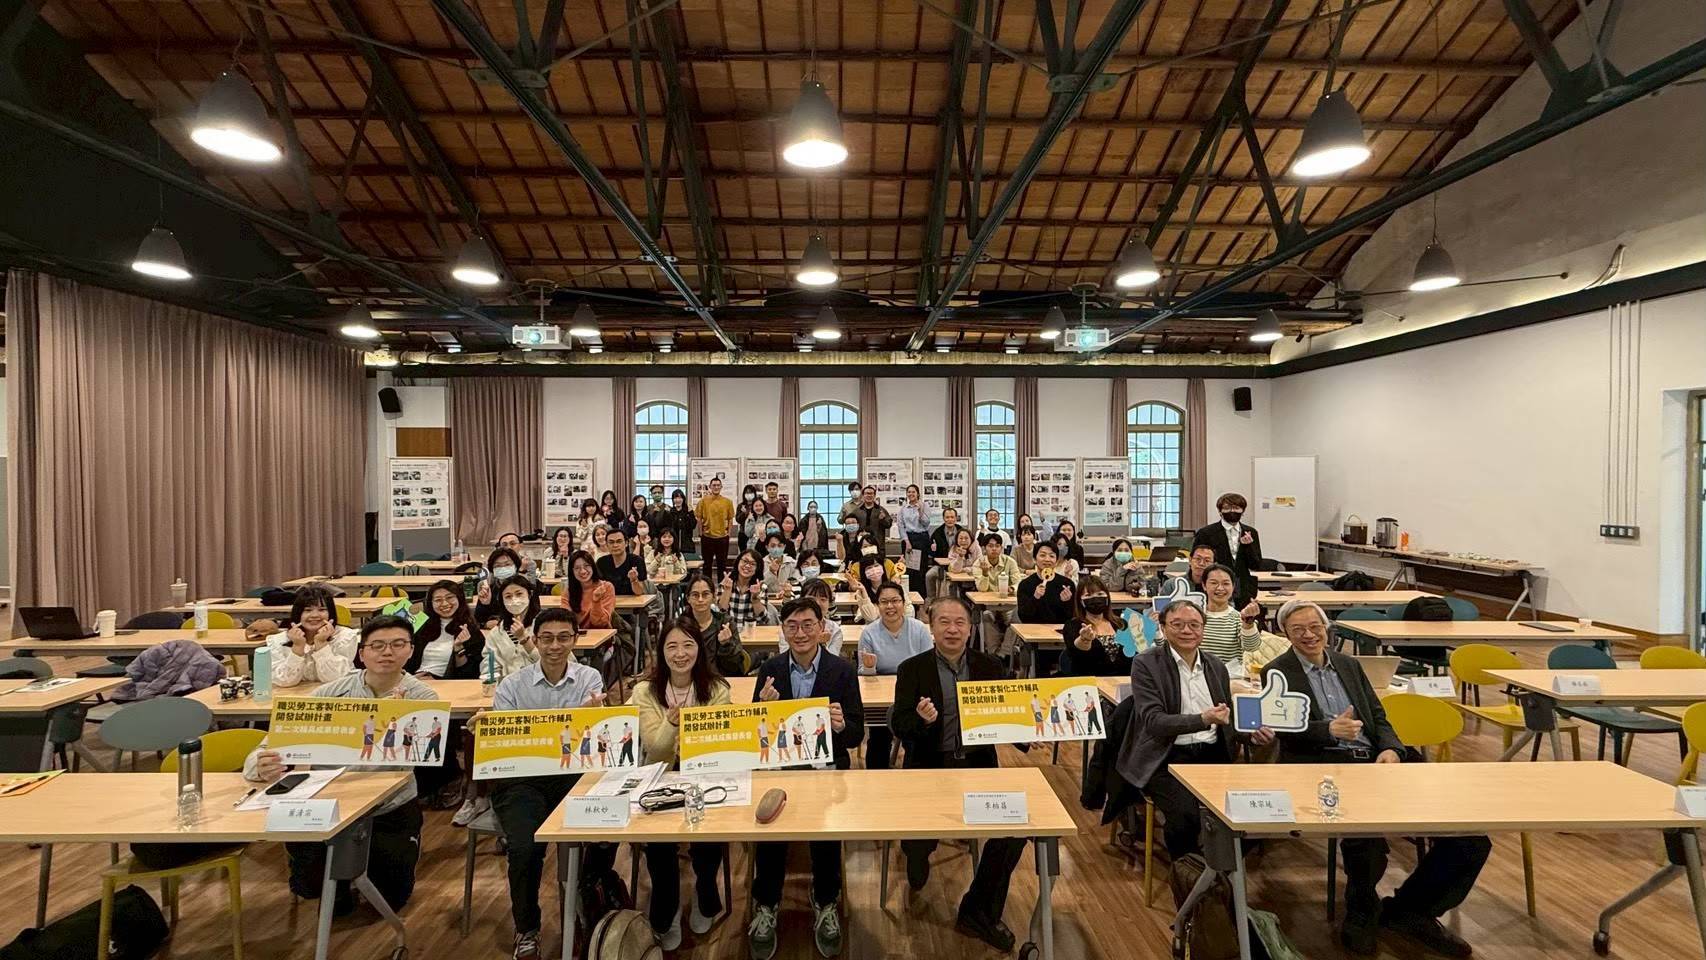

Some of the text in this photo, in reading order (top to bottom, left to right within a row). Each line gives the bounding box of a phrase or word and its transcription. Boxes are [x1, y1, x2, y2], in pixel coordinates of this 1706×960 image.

[961, 684, 1039, 695] 職災勞工客製化工作輔具
[277, 701, 379, 713] 職災勞工客製化工作輔具
[275, 712, 333, 722] 開發試辦計畫
[480, 714, 573, 726] 職災勞工客製化工作輔具
[683, 707, 769, 722] 職災勞工客製化工作輔具
[479, 726, 531, 737] 開發試辦計畫
[683, 720, 731, 732] 開發試辦計畫
